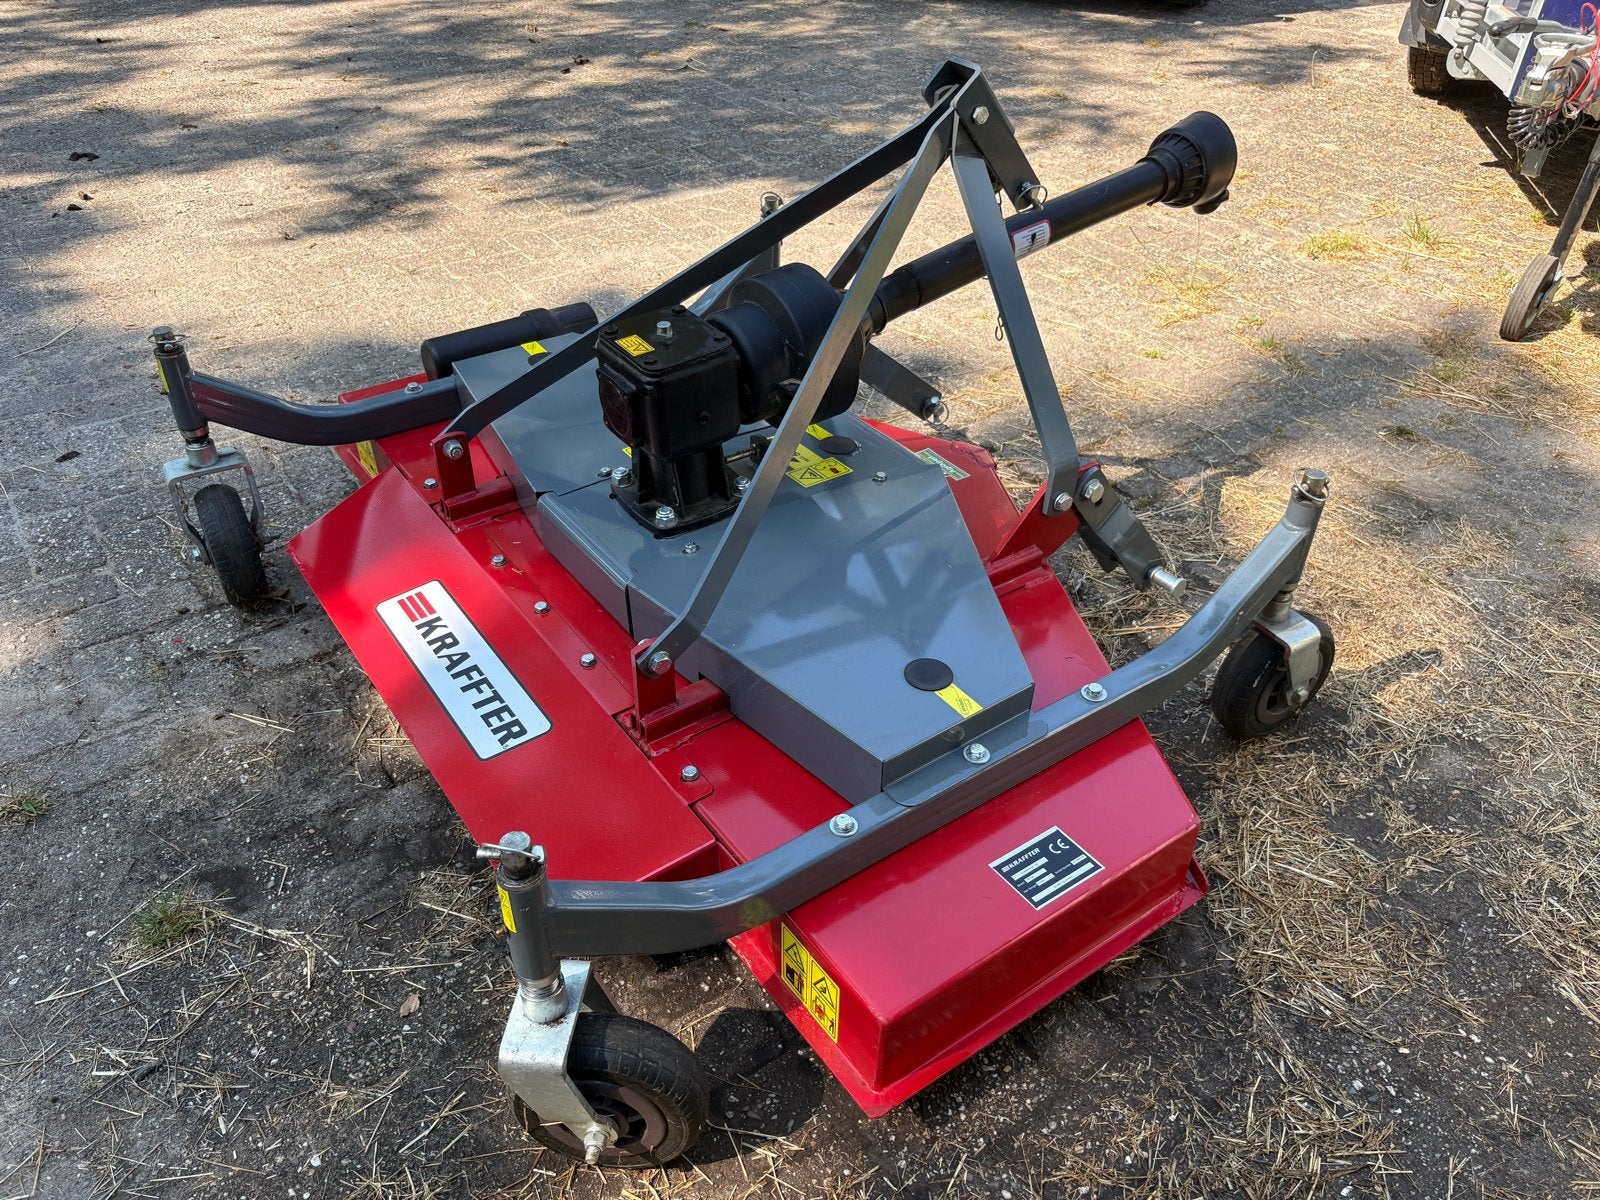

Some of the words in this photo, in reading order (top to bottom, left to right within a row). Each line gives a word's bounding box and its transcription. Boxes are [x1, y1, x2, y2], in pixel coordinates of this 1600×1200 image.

[415, 616, 528, 746] KRAFFTER
[1048, 838, 1070, 854] CE
[1008, 847, 1041, 869] KRAFFTER
